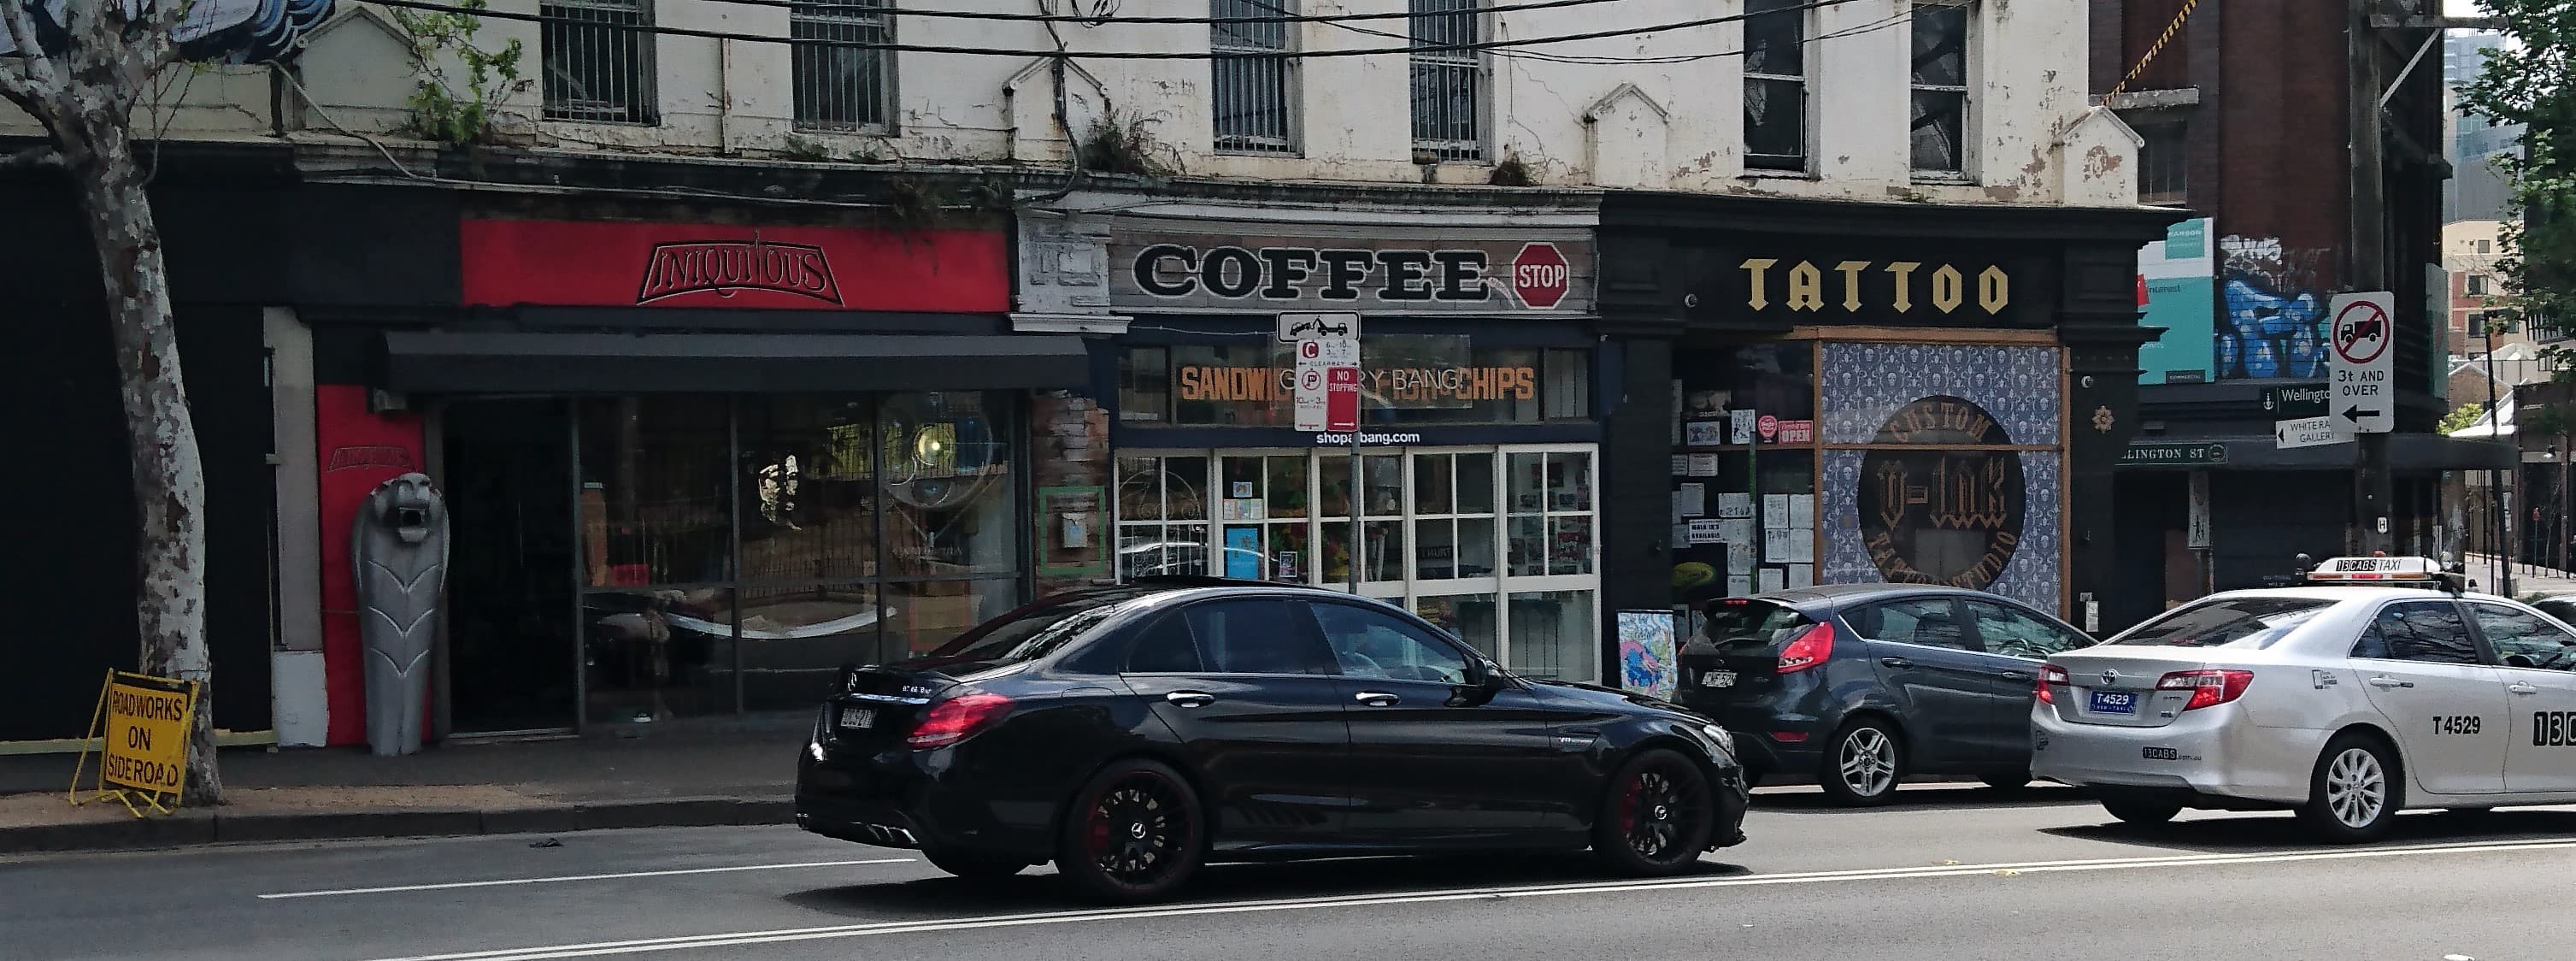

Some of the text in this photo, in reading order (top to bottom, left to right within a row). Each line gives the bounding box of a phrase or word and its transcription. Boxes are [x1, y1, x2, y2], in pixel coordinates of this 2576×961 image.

[650, 229, 827, 298] INIQUITOUS
[1132, 243, 1566, 302] COFFEE STOP
[1739, 258, 2008, 315] TATTOO
[1337, 371, 1350, 380] NO
[1392, 368, 1464, 391] BANG!
[2338, 370, 2385, 382] 3t AND
[1182, 366, 1294, 401] SANDWIC
[1456, 367, 1534, 400] CHIPS
[1329, 382, 1357, 392] STOPPING
[2343, 385, 2379, 396] OVER
[2282, 387, 2330, 404] Wellingto
[2291, 420, 2331, 432] WHITE RA
[1316, 427, 1420, 445] shopabang.com
[1781, 430, 1811, 443] OPEN
[2300, 432, 2335, 443] GALLERY
[2120, 448, 2205, 459] LINGTON ST
[2335, 558, 2401, 572] 13CABS TAXI
[112, 690, 183, 722] ROADWORKS
[2097, 693, 2130, 705] T4529
[128, 726, 152, 752] ON
